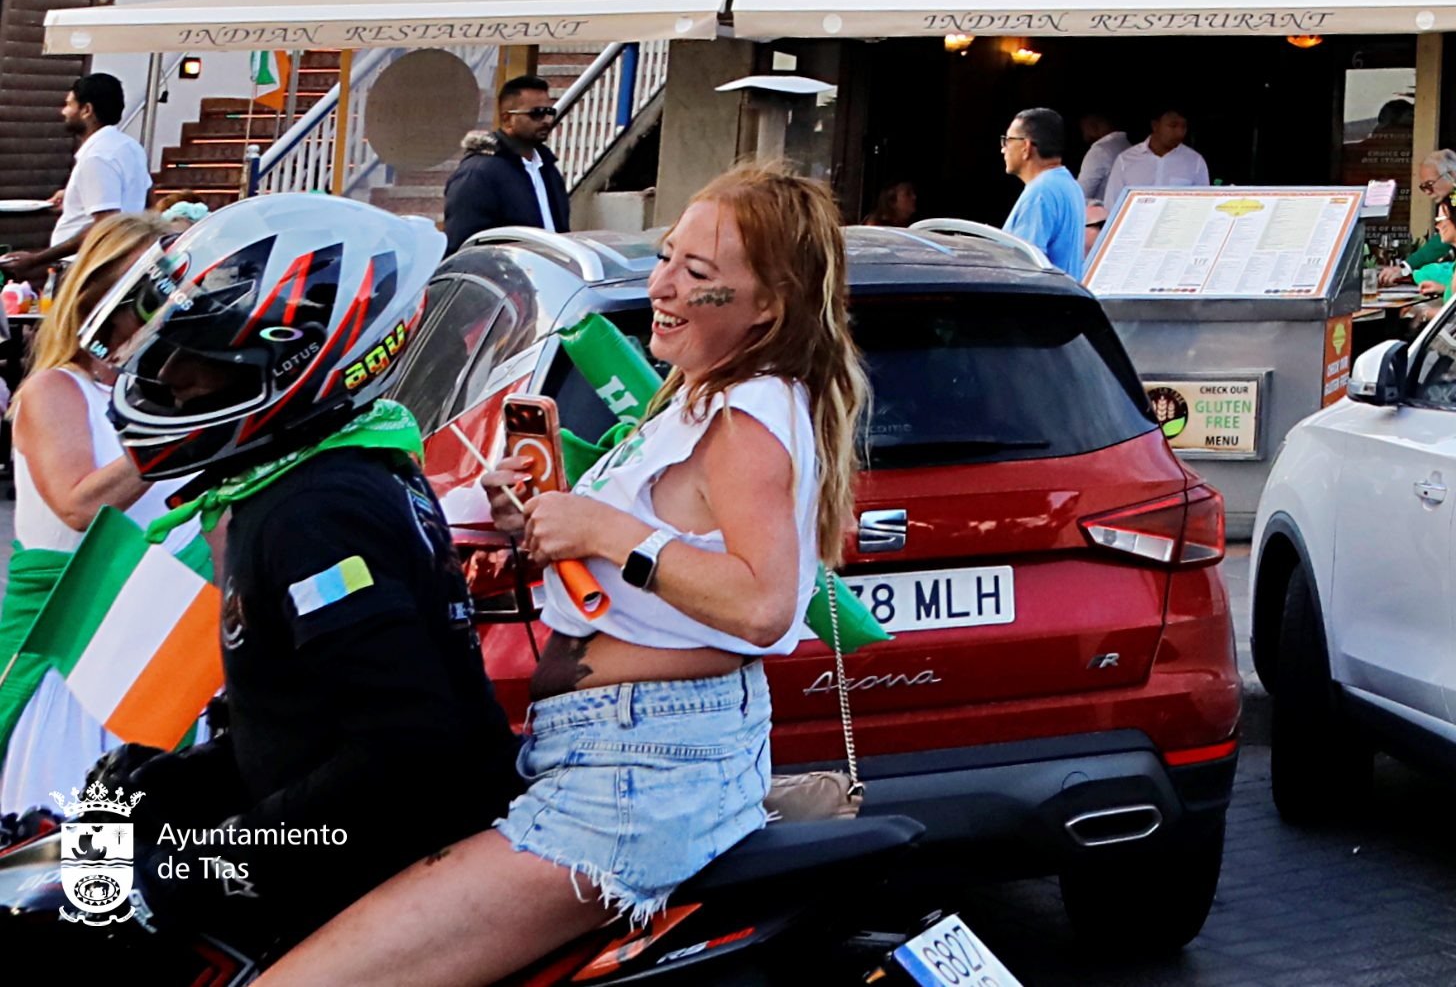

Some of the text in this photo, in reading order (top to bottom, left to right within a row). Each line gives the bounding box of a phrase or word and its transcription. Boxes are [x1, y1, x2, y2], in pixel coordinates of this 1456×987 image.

[178, 19, 590, 45] INDIAN RESTAURANT
[923, 11, 1336, 32] INDIAN RESTAURANT
[272, 341, 321, 378] LOTUS
[344, 321, 407, 390] agv
[1199, 385, 1249, 395] CHECK OUR
[1194, 399, 1252, 414] GLUTEN
[1205, 415, 1241, 429] FREE
[1205, 435, 1239, 446] MENU
[914, 574, 1001, 621] MLH
[922, 924, 987, 985] 6827
